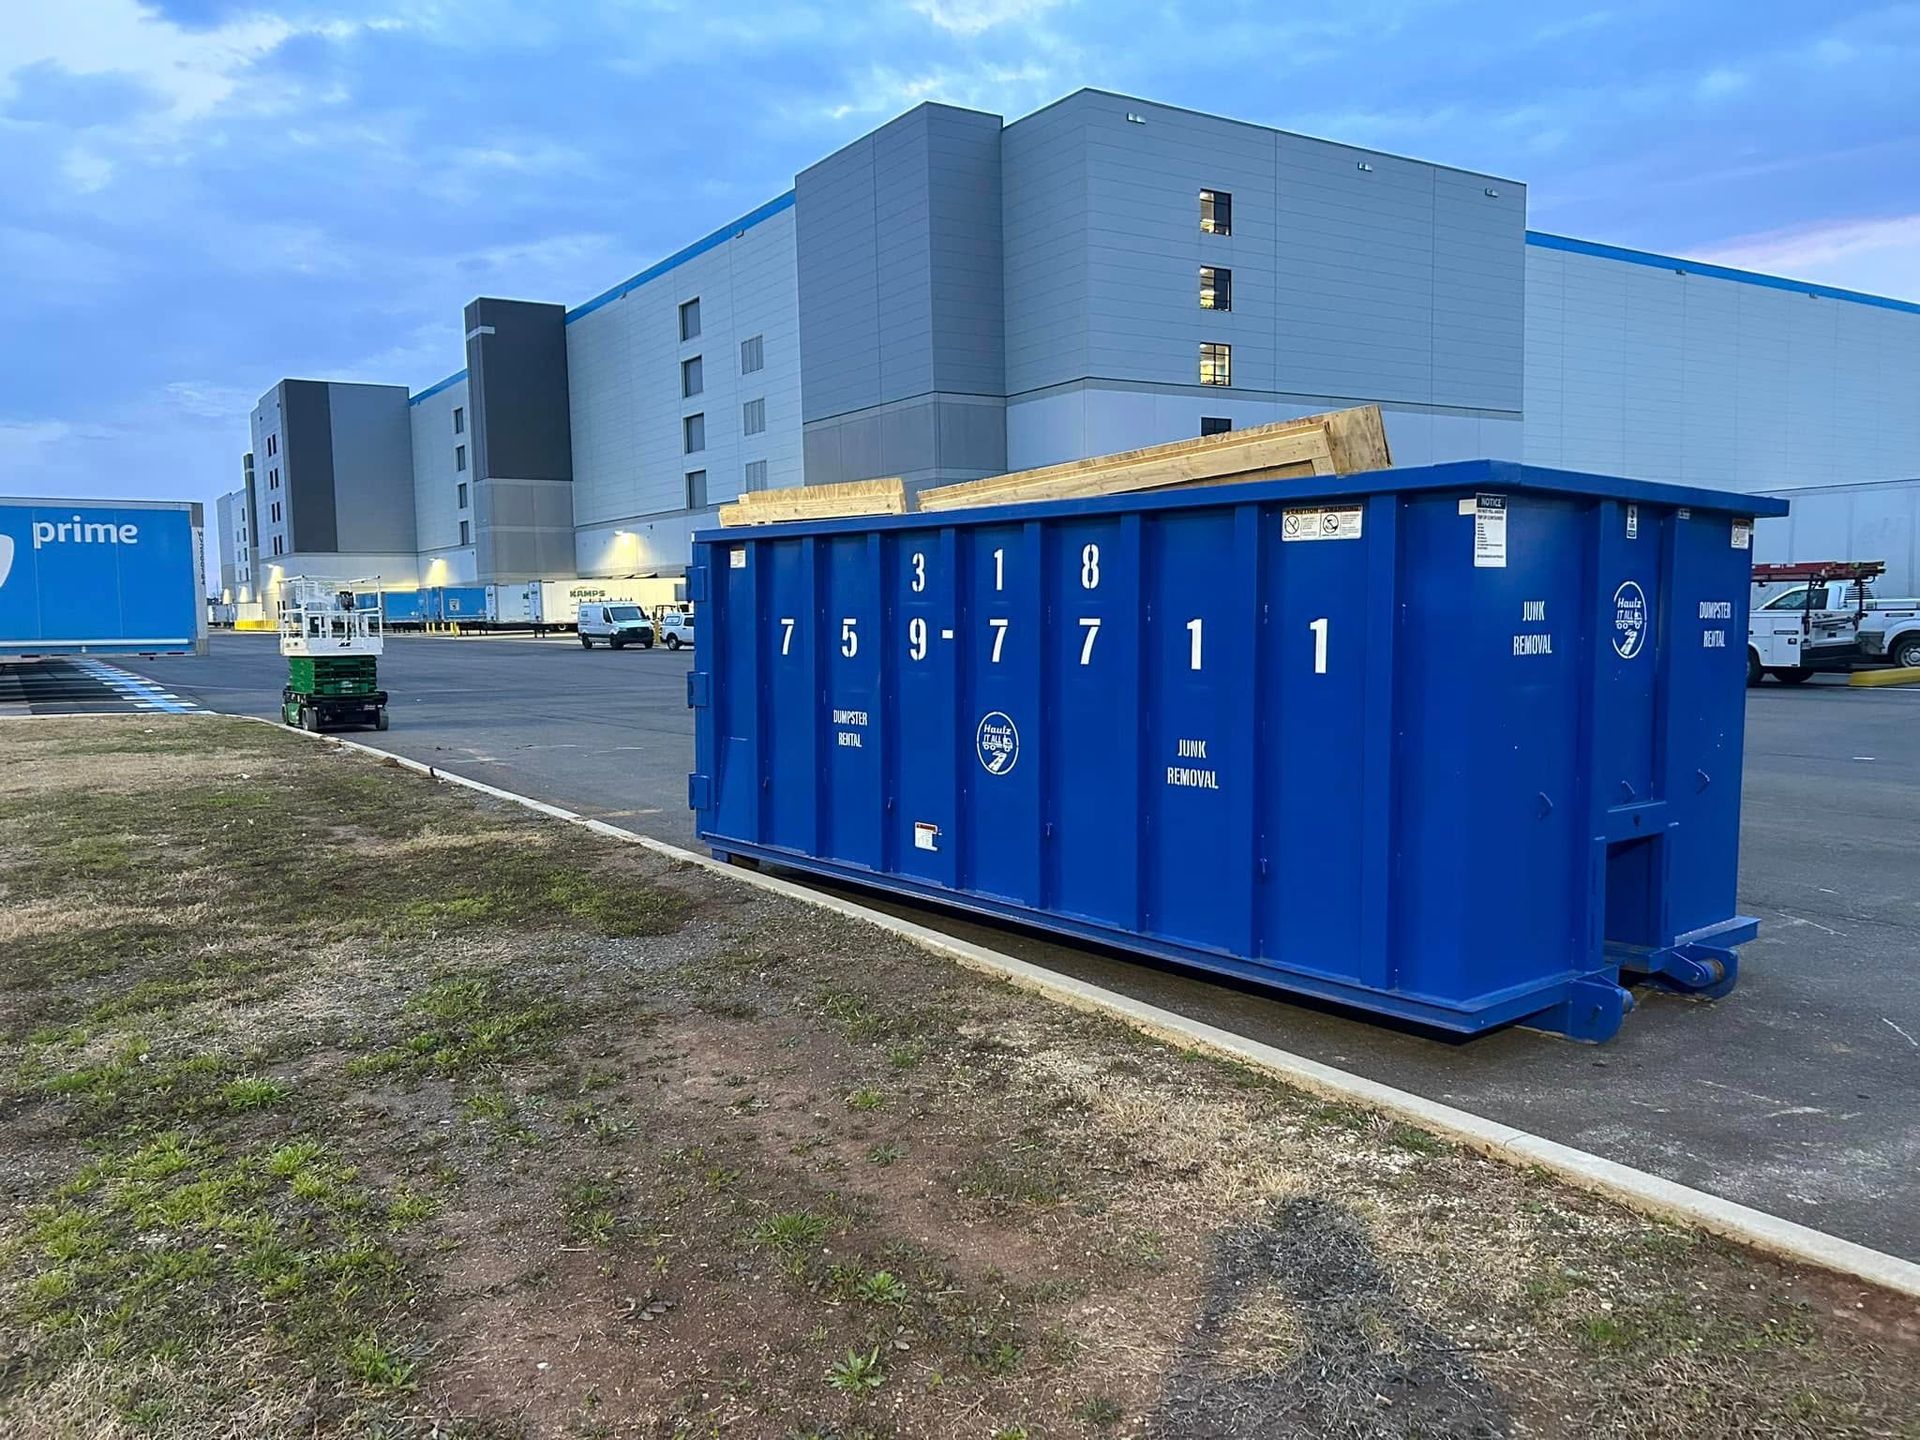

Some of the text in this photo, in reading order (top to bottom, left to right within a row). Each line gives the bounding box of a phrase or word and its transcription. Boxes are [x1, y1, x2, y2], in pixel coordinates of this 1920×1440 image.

[1481, 498, 1502, 507] NOTICE
[32, 515, 138, 550] prime
[570, 590, 606, 598] KAMPS
[1617, 597, 1642, 608] Haulz
[1522, 600, 1545, 622] JUNK
[1699, 601, 1731, 620] DUMPSTER
[1513, 634, 1552, 656] REMOVAL
[1703, 630, 1726, 648] RENTAL
[832, 709, 868, 727] DUMPSTER
[984, 723, 1011, 734] Haulz
[838, 732, 862, 748] RENTAL
[1177, 739, 1207, 759] JUNK
[1167, 767, 1219, 789] REMOVAL
